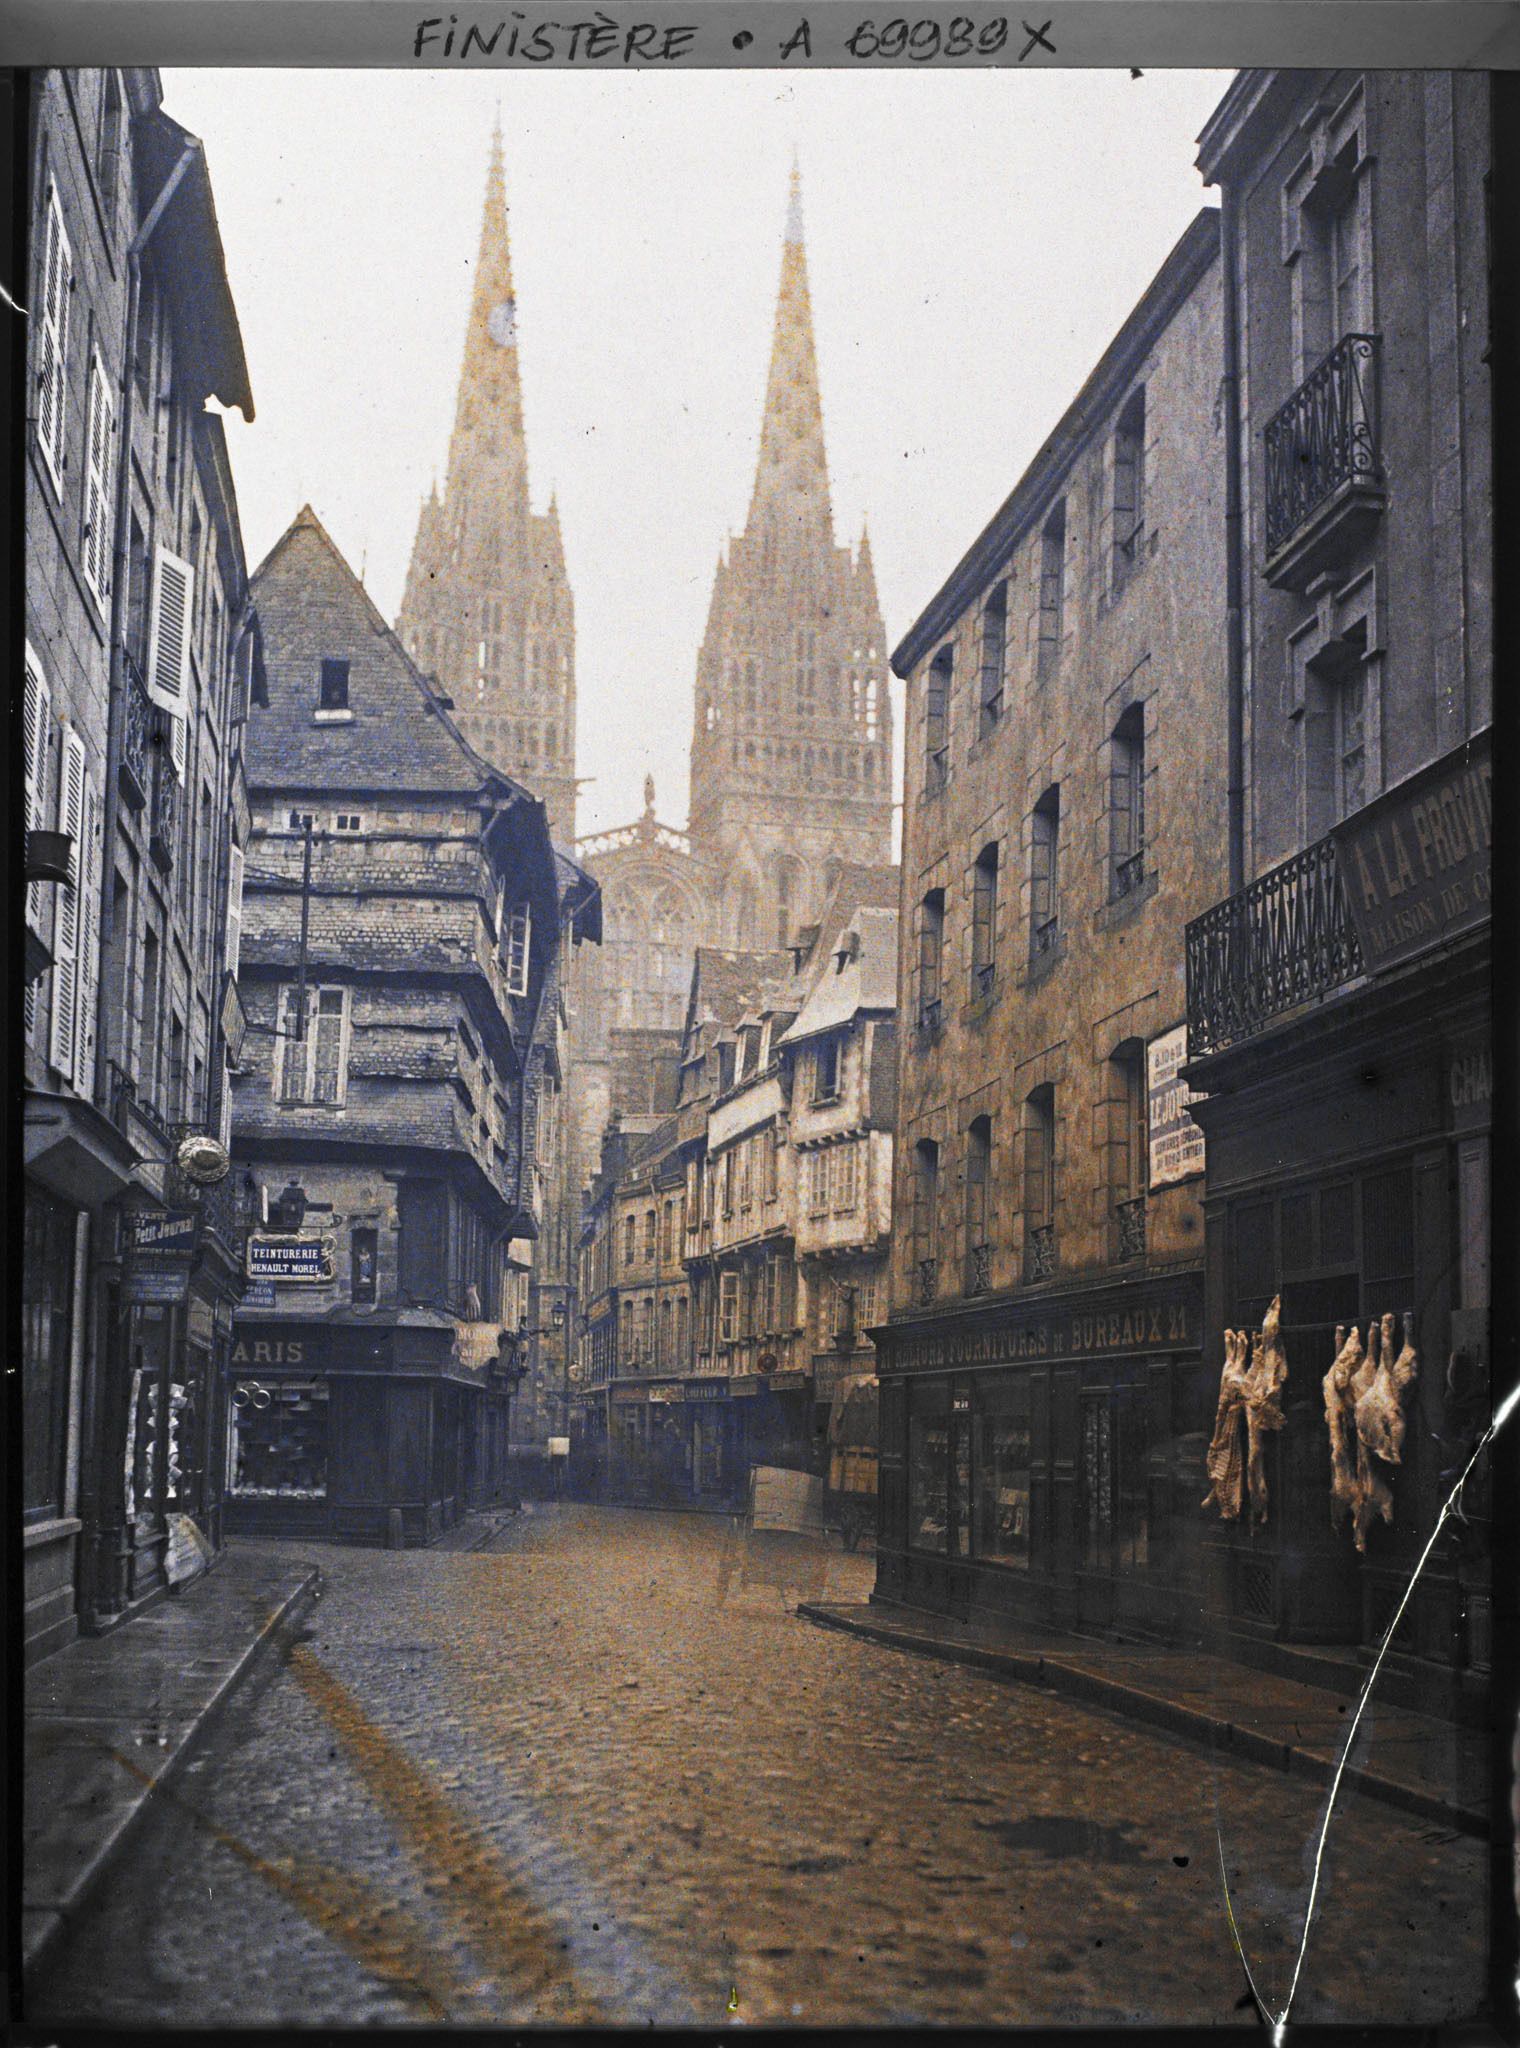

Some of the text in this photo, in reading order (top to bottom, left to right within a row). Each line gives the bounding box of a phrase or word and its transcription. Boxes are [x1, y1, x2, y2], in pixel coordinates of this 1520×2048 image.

[1375, 820, 1418, 898] LA
[1370, 897, 1438, 955] MAISON
[1441, 881, 1469, 919] DE
[1150, 1096, 1162, 1128] LE
[133, 1224, 156, 1244] Petit
[157, 1215, 194, 1239] Journal
[251, 1263, 320, 1274] HENAULT MOREL
[253, 1248, 319, 1260] TEINTURERIE
[948, 1327, 1047, 1364] FOURNITURES
[1071, 1308, 1162, 1352] BUREAUX
[1168, 1304, 1186, 1341] 21
